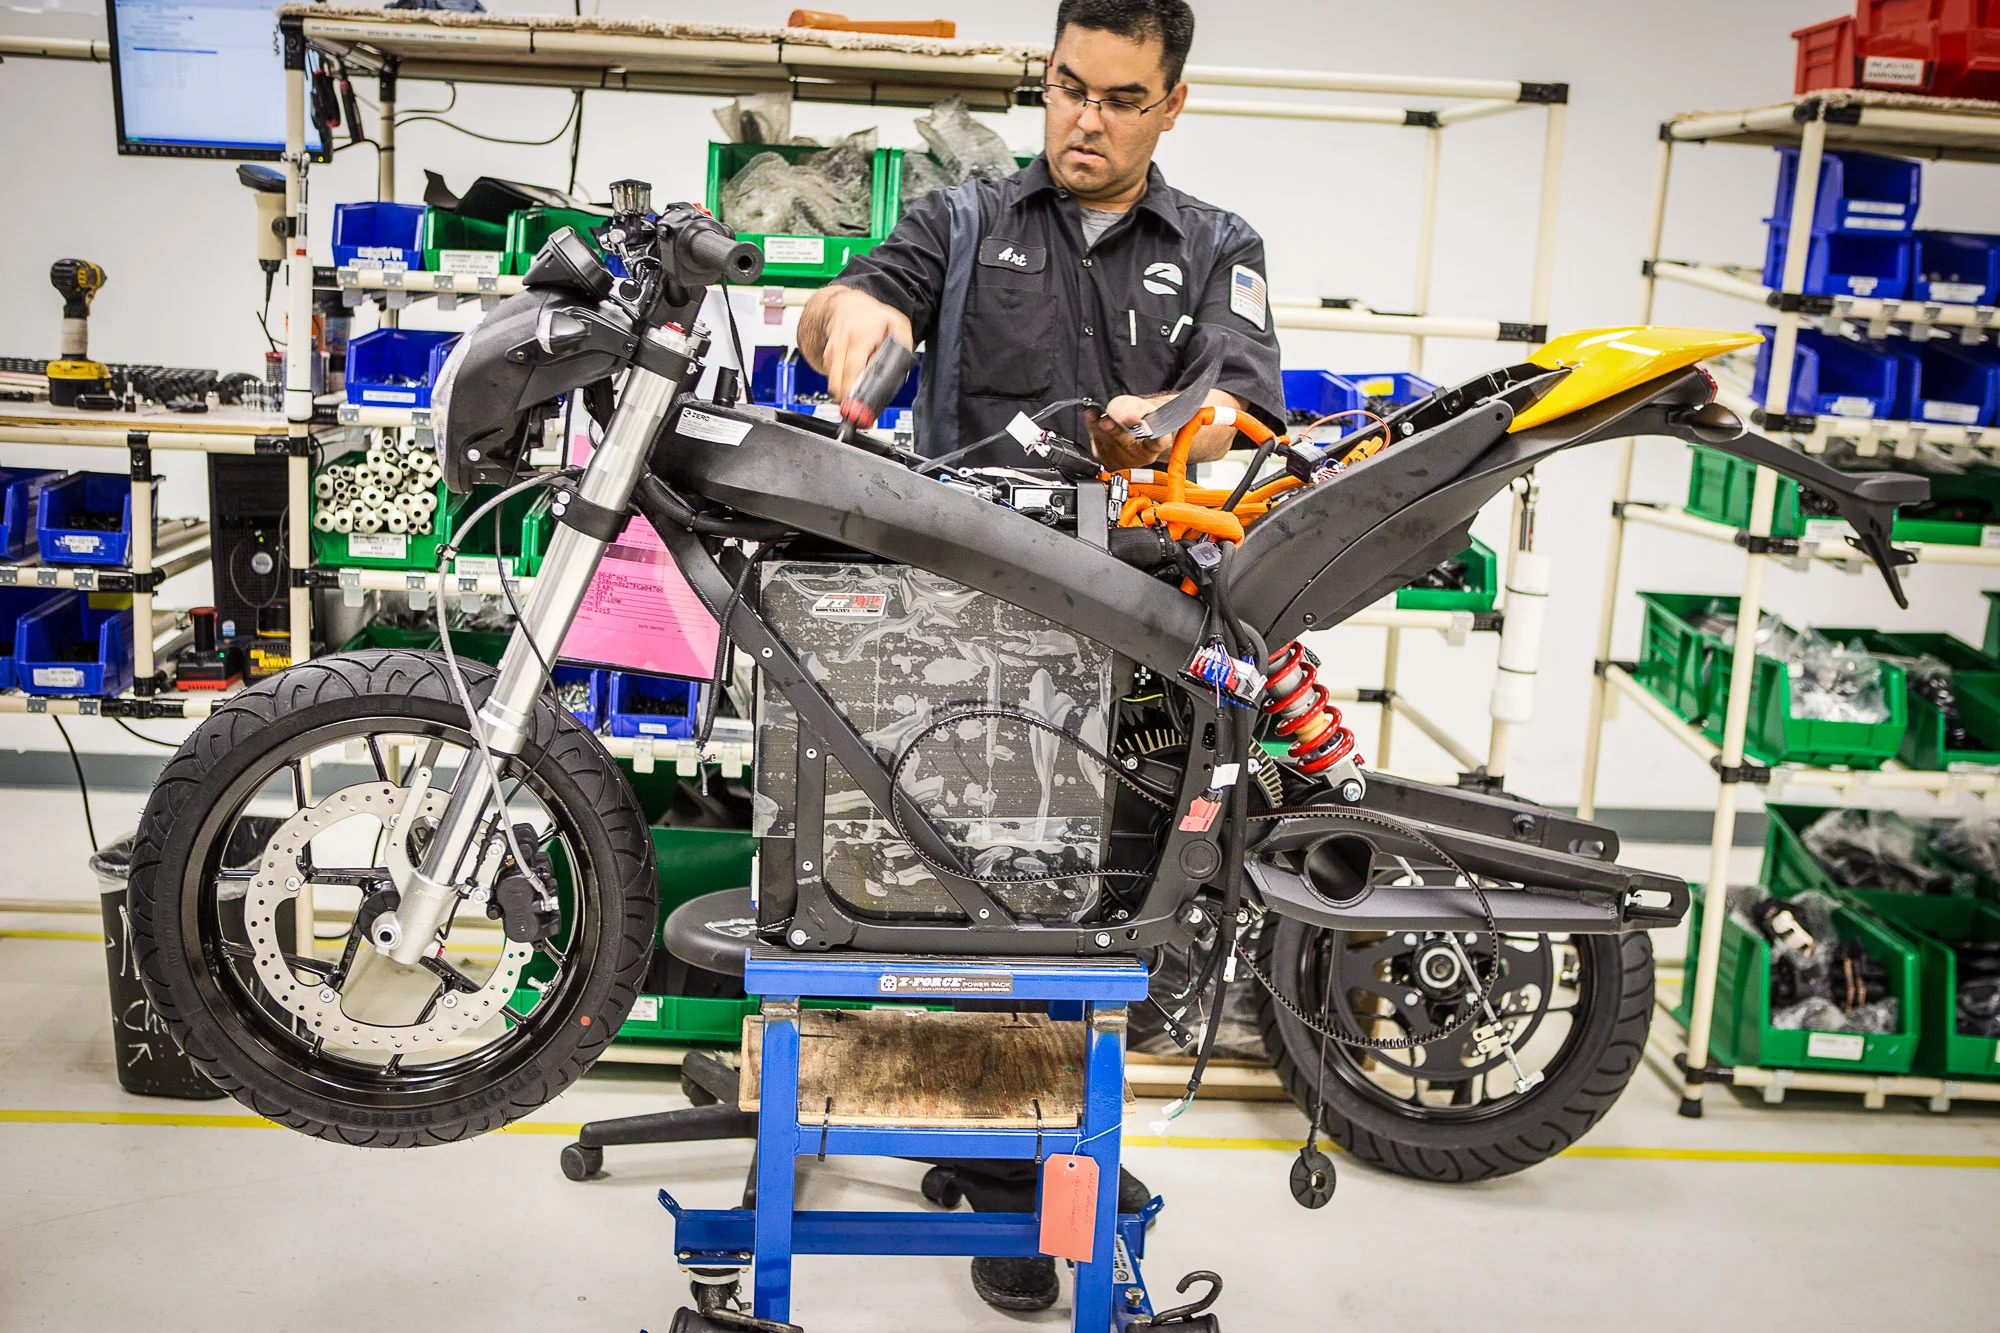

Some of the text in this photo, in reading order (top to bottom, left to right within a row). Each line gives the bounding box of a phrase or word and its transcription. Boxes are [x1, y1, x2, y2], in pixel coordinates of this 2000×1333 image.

[998, 246, 1027, 267] Art
[691, 412, 710, 422] ZERO
[897, 977, 963, 987] Z-FORCE
[327, 1102, 435, 1128] DEMON
